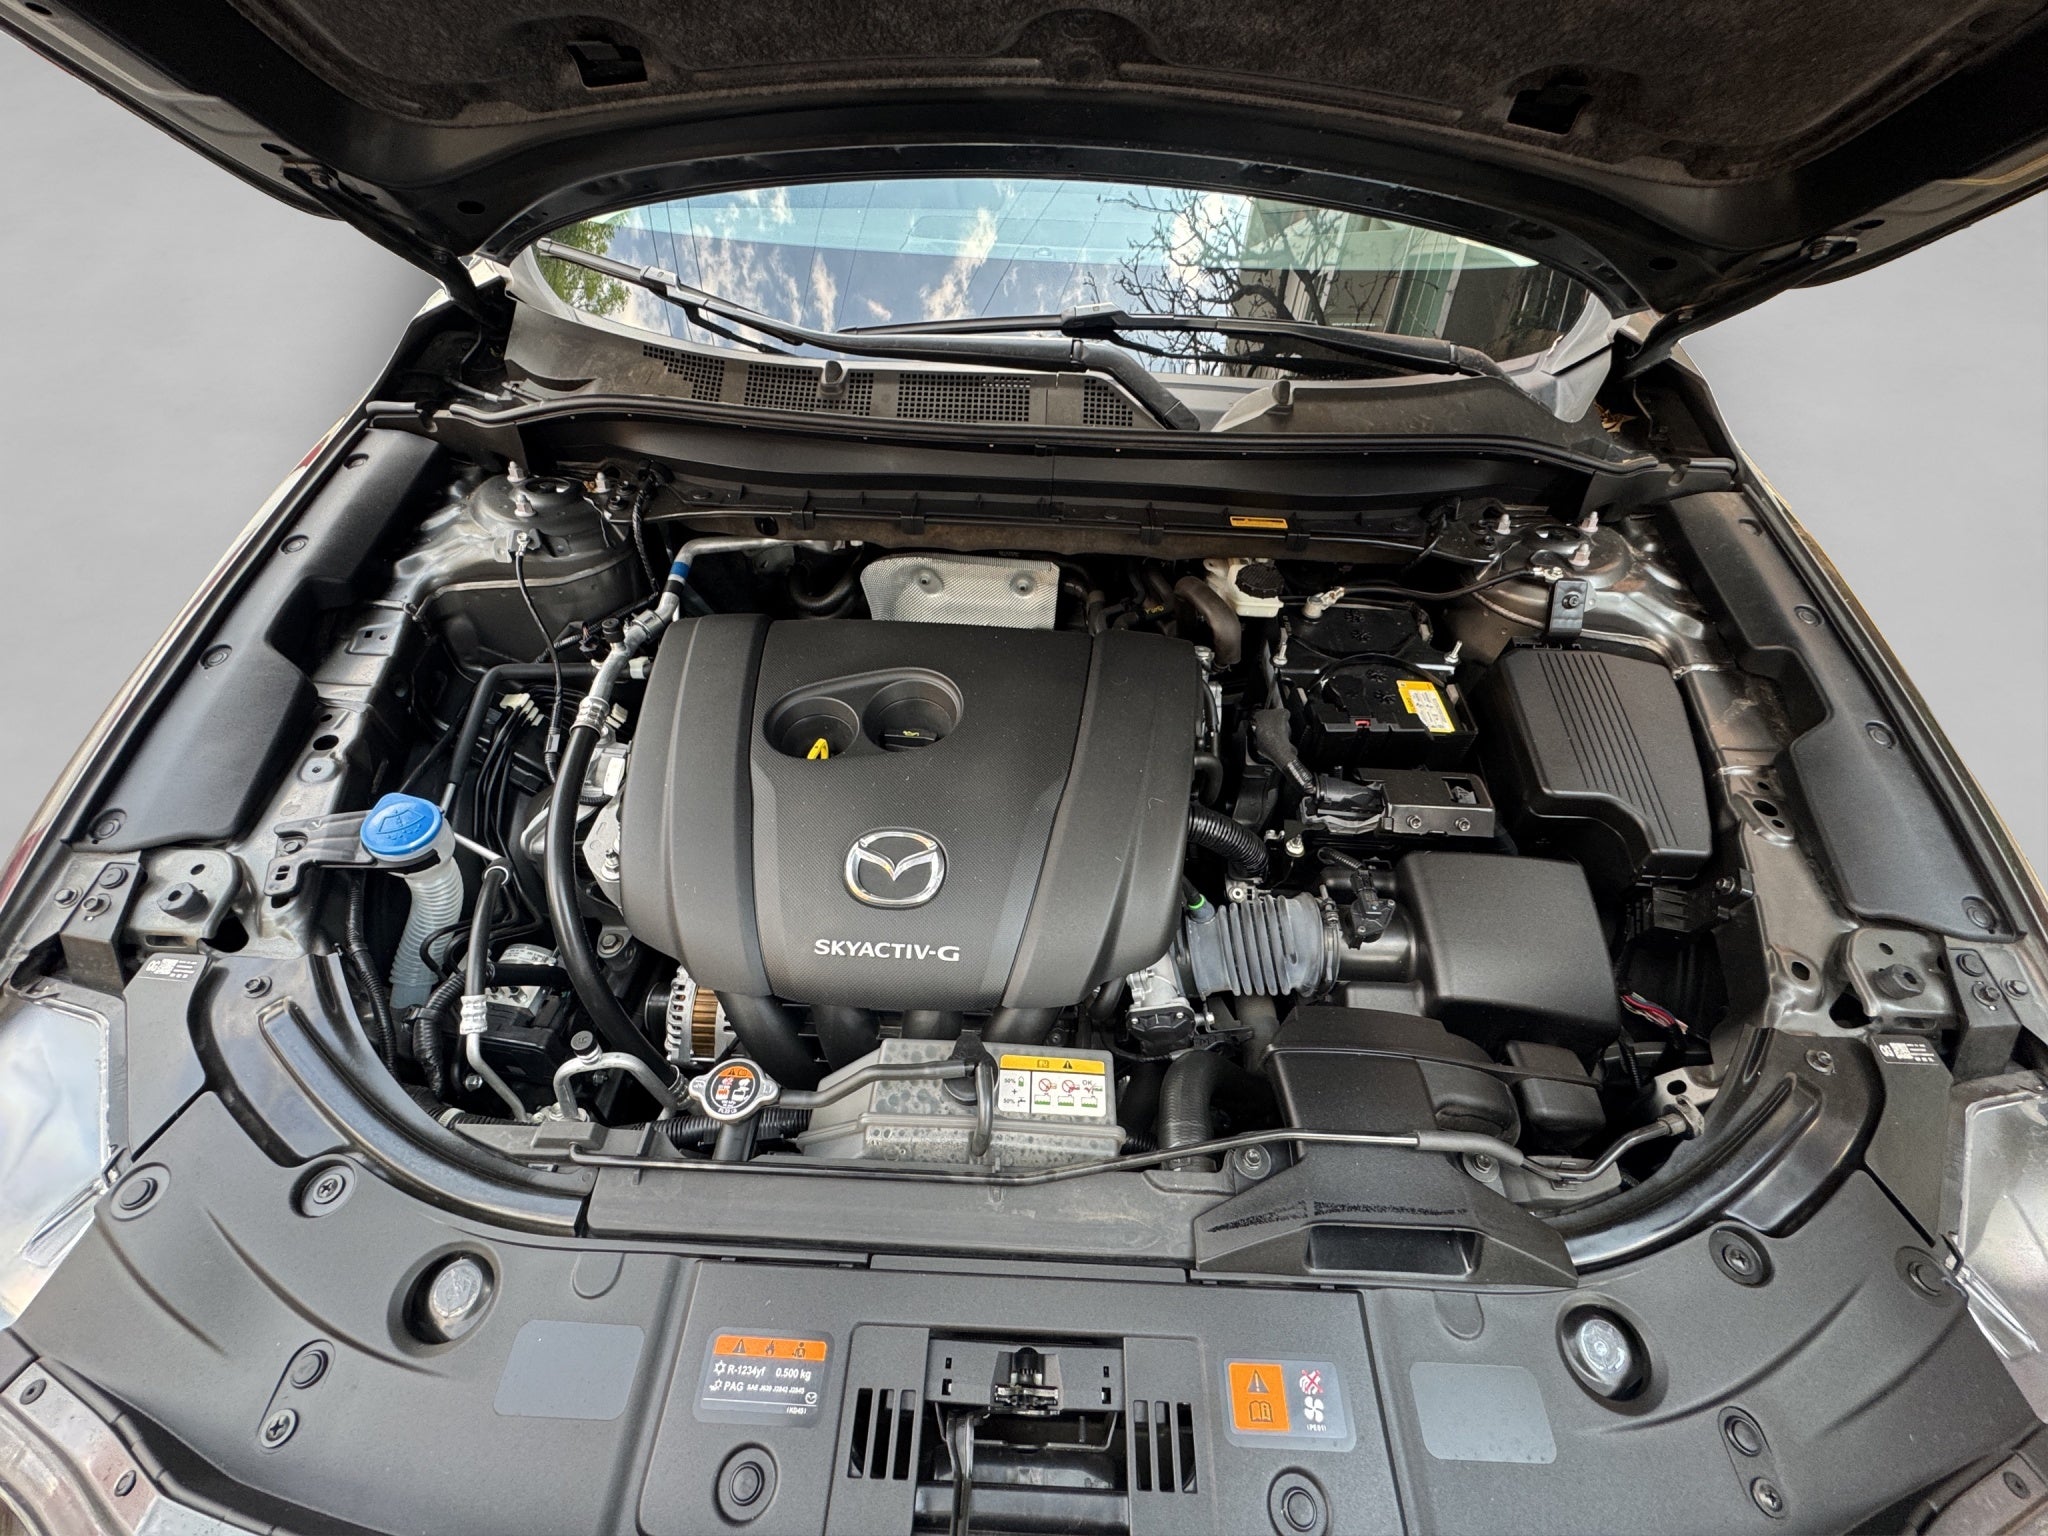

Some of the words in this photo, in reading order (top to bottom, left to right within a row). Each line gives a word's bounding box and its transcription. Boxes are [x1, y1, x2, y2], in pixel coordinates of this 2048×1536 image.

[814, 939, 960, 962] SKYACTIV-G
[727, 1365, 766, 1378] R-1234yf
[775, 1367, 799, 1379] 0.500
[799, 1368, 812, 1382] kg
[723, 1381, 744, 1392] PAG
